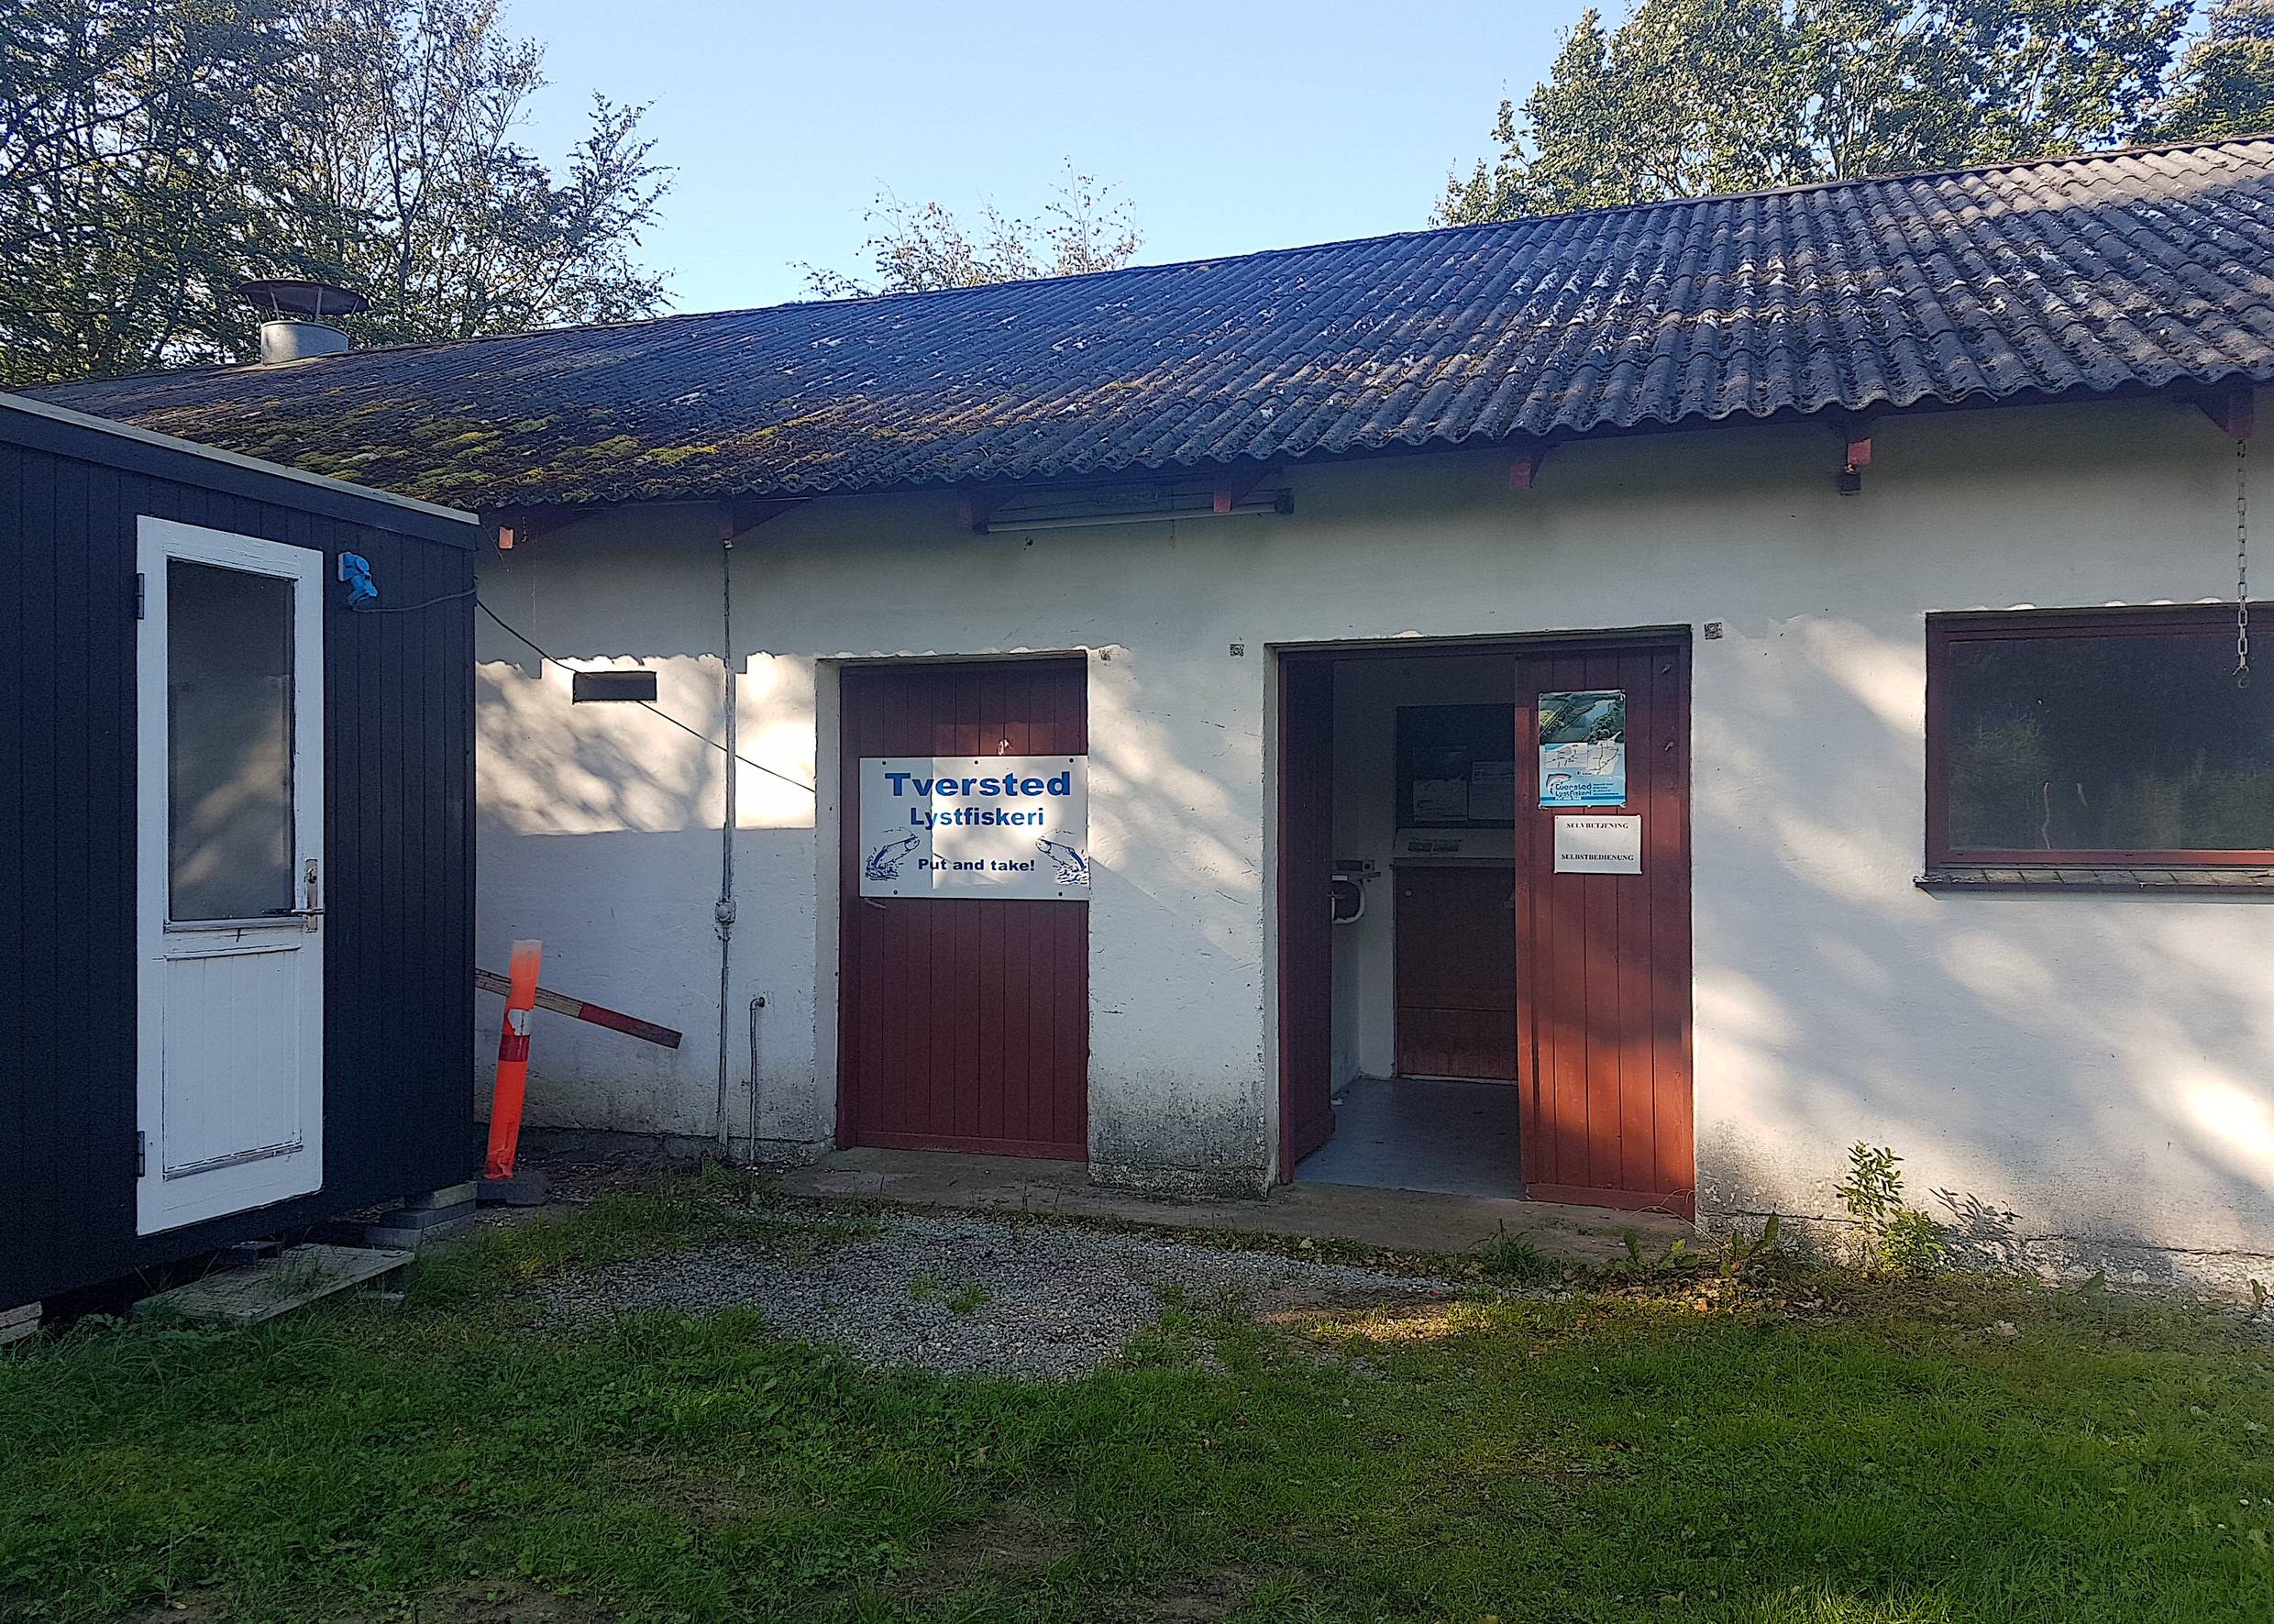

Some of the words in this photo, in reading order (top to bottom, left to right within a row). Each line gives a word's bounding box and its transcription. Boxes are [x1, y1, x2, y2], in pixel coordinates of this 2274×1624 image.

[885, 771, 1071, 797] Tversted
[911, 807, 1044, 830] Lystfiskeri
[918, 859, 952, 870] Put
[953, 859, 985, 871] and
[991, 859, 1035, 871] take!
